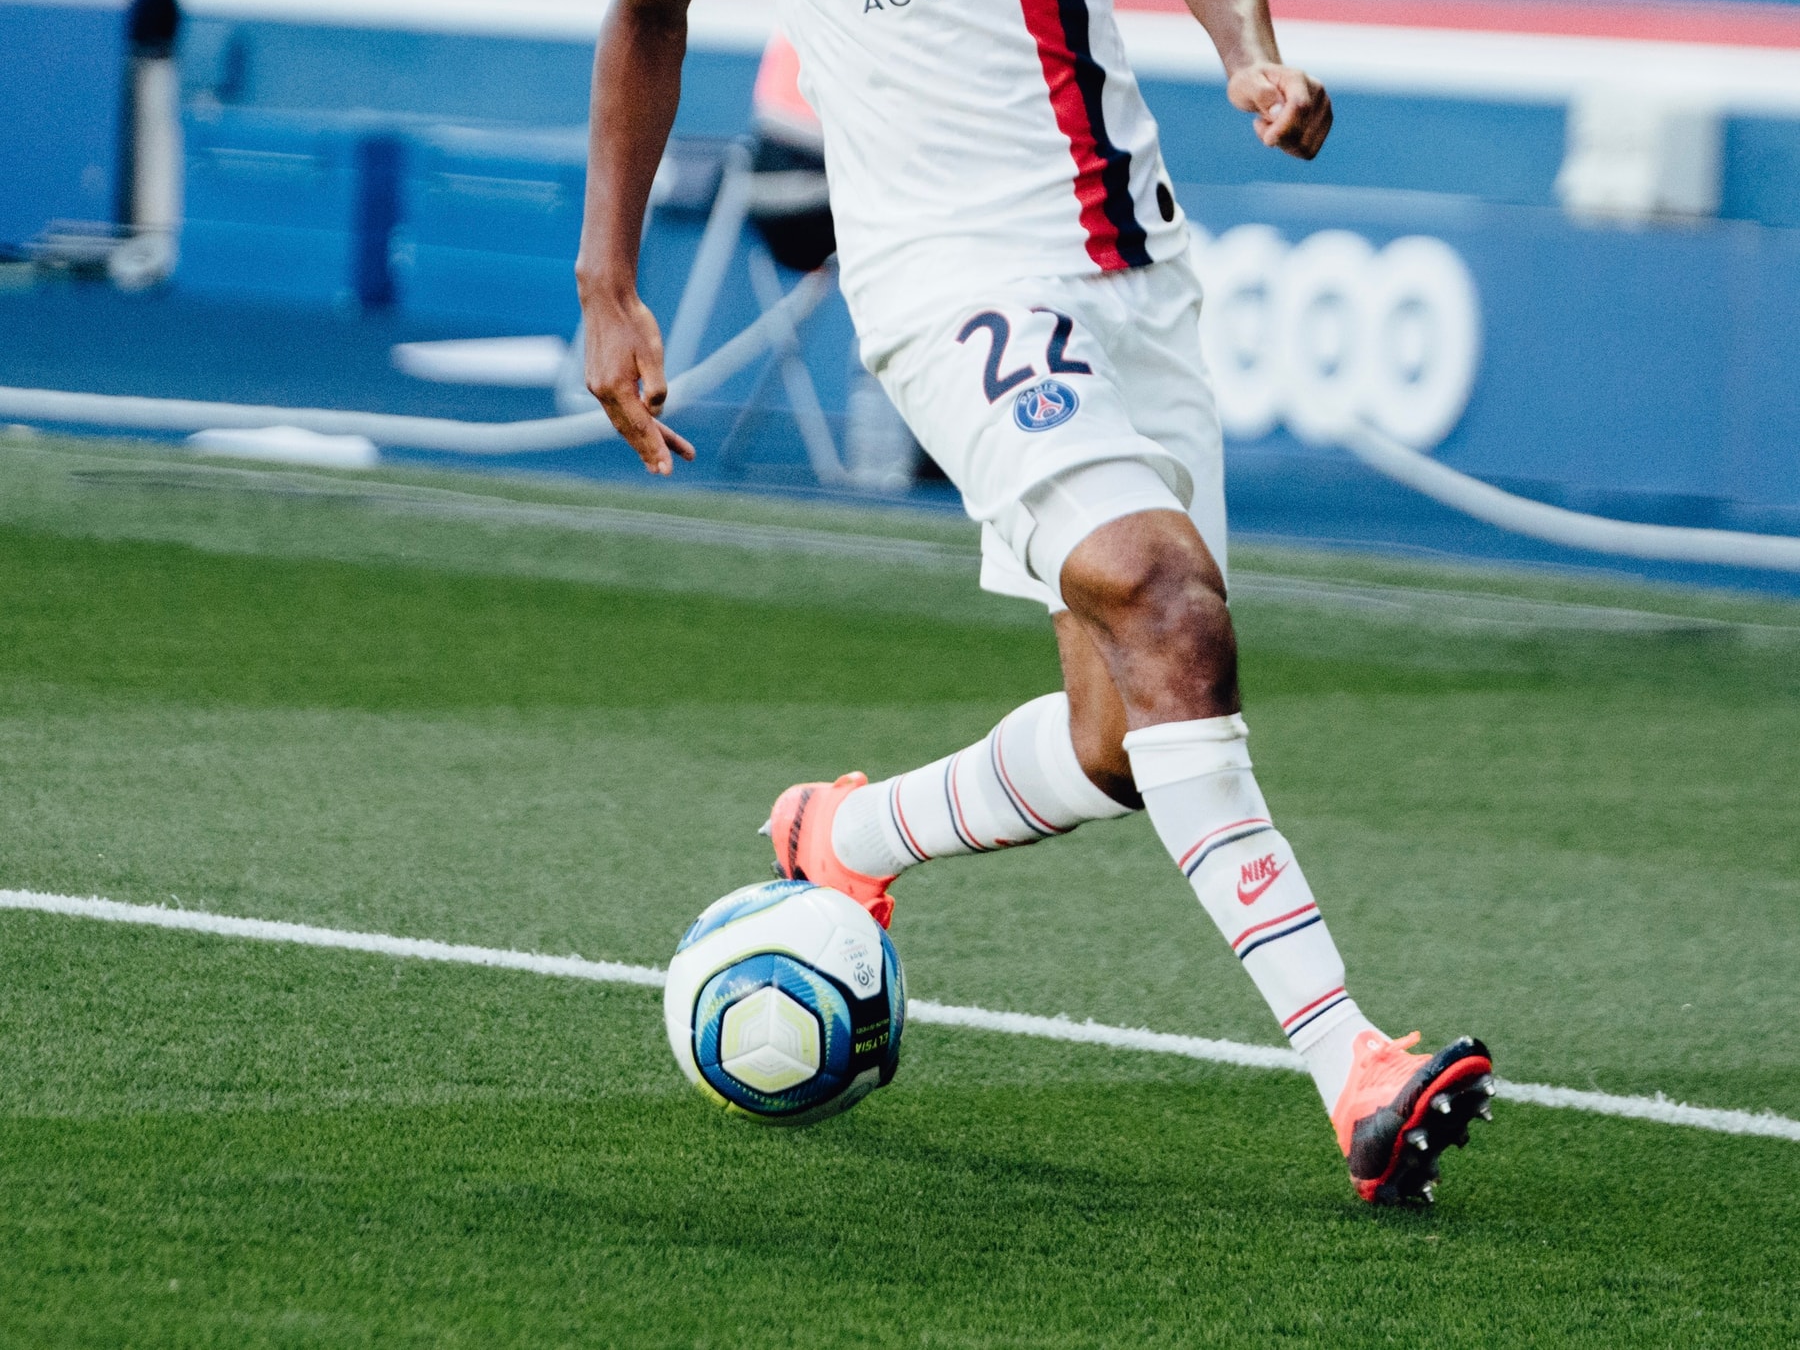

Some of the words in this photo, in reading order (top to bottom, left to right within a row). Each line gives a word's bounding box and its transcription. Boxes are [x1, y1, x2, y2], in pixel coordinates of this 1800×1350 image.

[955, 306, 1094, 405] 22
[1020, 383, 1059, 405] PARIS
[1241, 852, 1277, 885] NIKE
